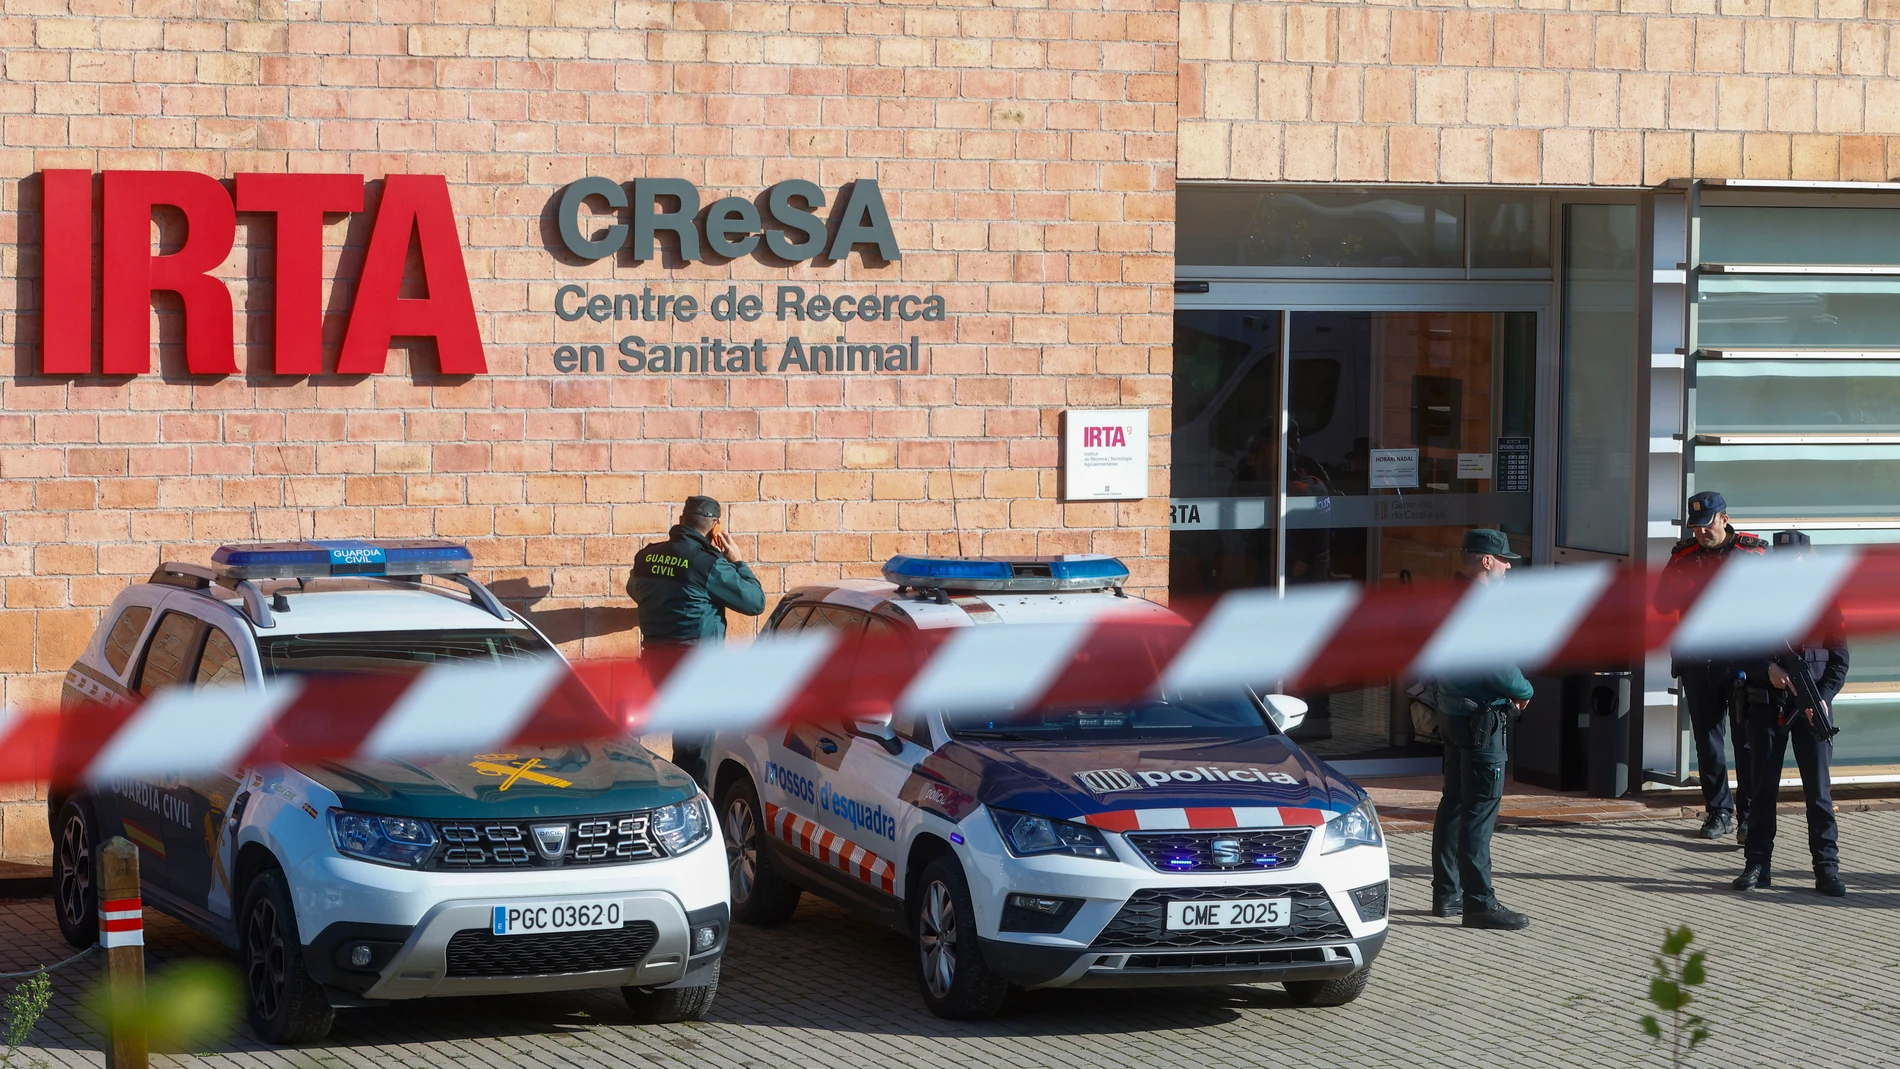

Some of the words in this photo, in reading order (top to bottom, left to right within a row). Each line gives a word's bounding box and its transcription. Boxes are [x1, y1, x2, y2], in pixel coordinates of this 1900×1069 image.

[558, 176, 901, 261] CReSA
[41, 169, 488, 374] IRTA
[556, 284, 699, 322] Centre
[711, 285, 763, 322] de
[776, 285, 946, 322] Recerca
[553, 344, 604, 373] en
[618, 335, 768, 373] Sanitat
[778, 336, 920, 373] Animal
[1084, 426, 1126, 447] IRTA
[333, 548, 381, 558] GUARDIA
[345, 556, 373, 564] CIVIL
[645, 553, 689, 569] GUARDIA
[651, 564, 675, 577] CIVIL
[1136, 766, 1300, 787] policia
[163, 793, 192, 830] CIVIL
[764, 760, 815, 805] mossos
[820, 780, 896, 842] d'esquadra
[508, 907, 548, 931] PGC
[1182, 904, 1221, 926] CME
[1230, 902, 1279, 925] 2025
